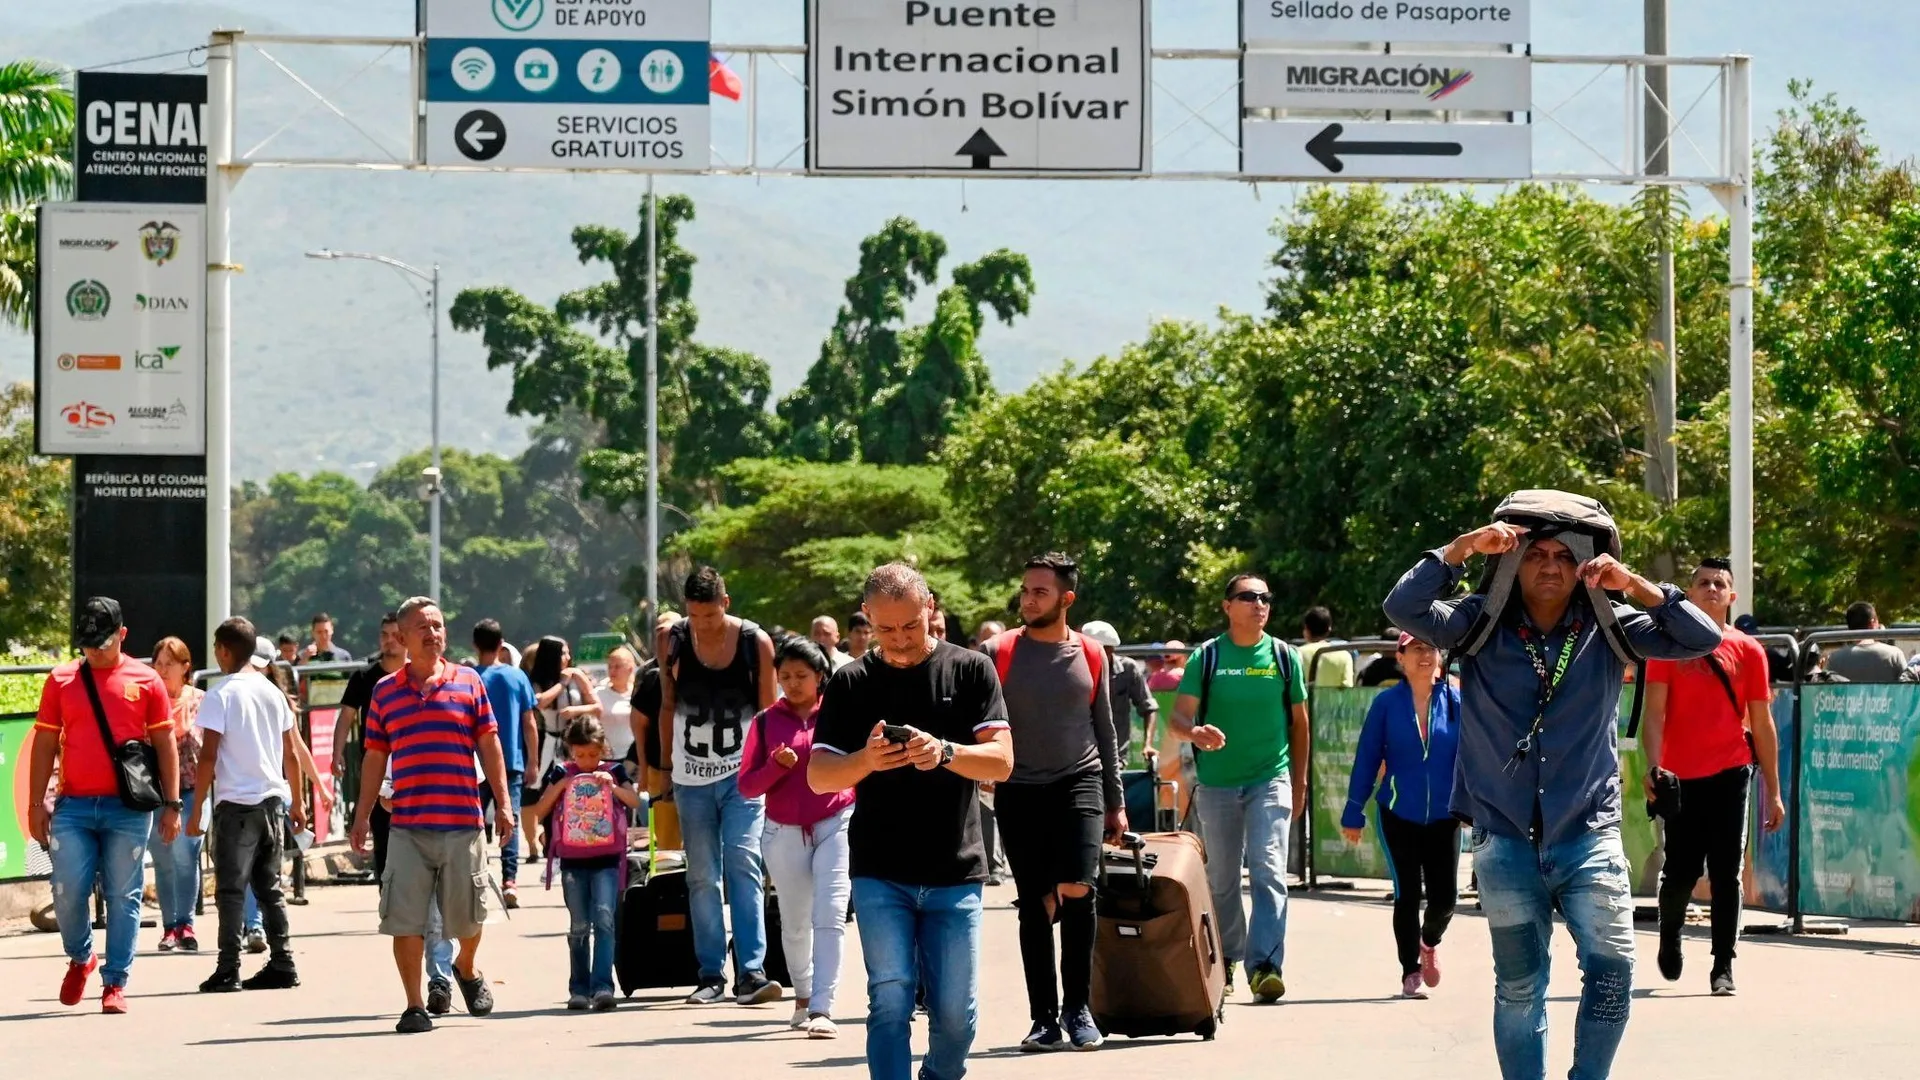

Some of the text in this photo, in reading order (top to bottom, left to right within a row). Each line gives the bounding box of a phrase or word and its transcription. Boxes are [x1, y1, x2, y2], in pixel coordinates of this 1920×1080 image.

[556, 9, 645, 26] DE APOYO
[905, 1, 1056, 27] Puente
[1271, 1, 1511, 24] Sellado de Pasaporte
[834, 45, 1119, 74] Internacional
[1287, 63, 1450, 87] MIGRACIÓN
[831, 88, 1129, 120] Simón Bolívar
[557, 116, 677, 135] SERVICIOS
[92, 150, 207, 164] CENTRO NACIONAL D
[551, 141, 683, 159] GRATUITOS
[85, 161, 207, 177] ATENCIÓN EN FRONTER
[149, 297, 189, 310] DIAN
[135, 351, 164, 370] ica
[85, 472, 139, 485] REPÚBLICA
[142, 474, 156, 485] DE
[94, 486, 207, 499] NORTE DE SANTANDER
[1552, 634, 1576, 687] SUZUKI
